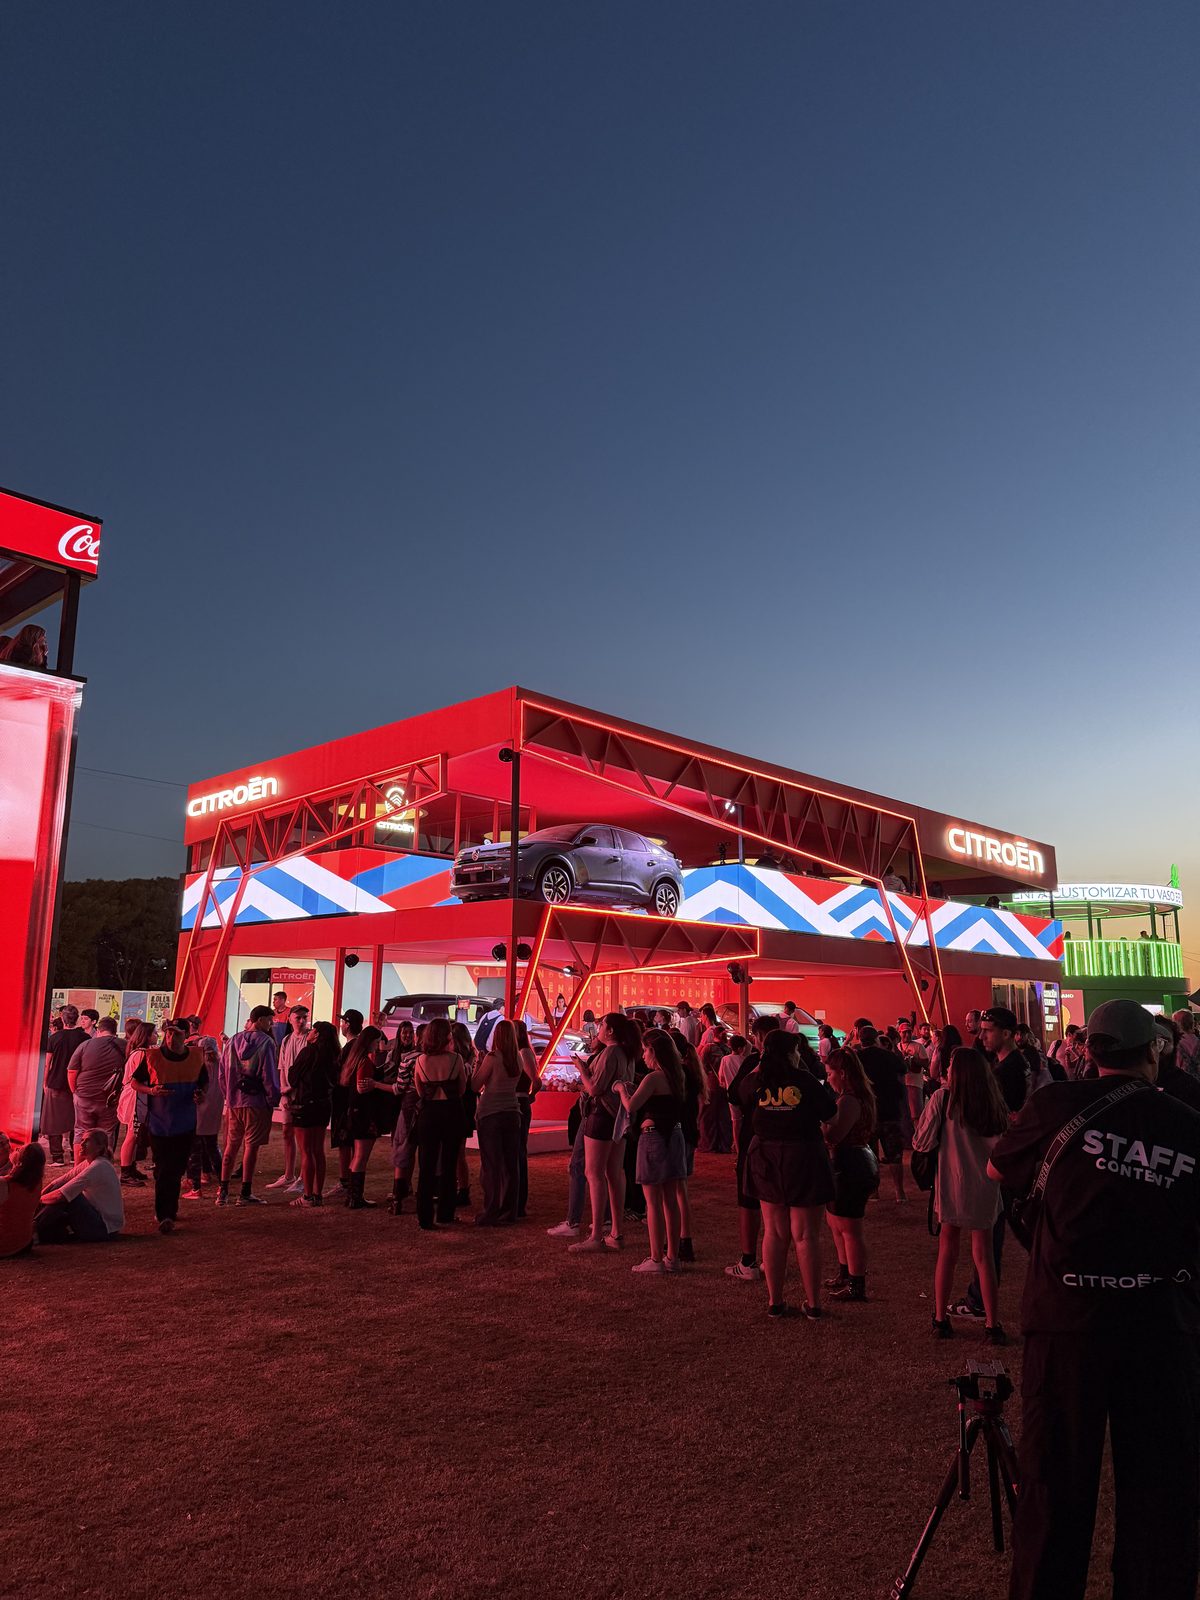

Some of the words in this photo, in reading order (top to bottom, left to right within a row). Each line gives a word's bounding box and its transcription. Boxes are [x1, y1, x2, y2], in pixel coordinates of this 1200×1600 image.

[1140, 887, 1155, 900] TU
[1156, 888, 1175, 903] VASO
[1056, 1114, 1087, 1144] TRICERA
[1081, 1129, 1197, 1178] STAFF
[1095, 1157, 1175, 1189] CONTENT
